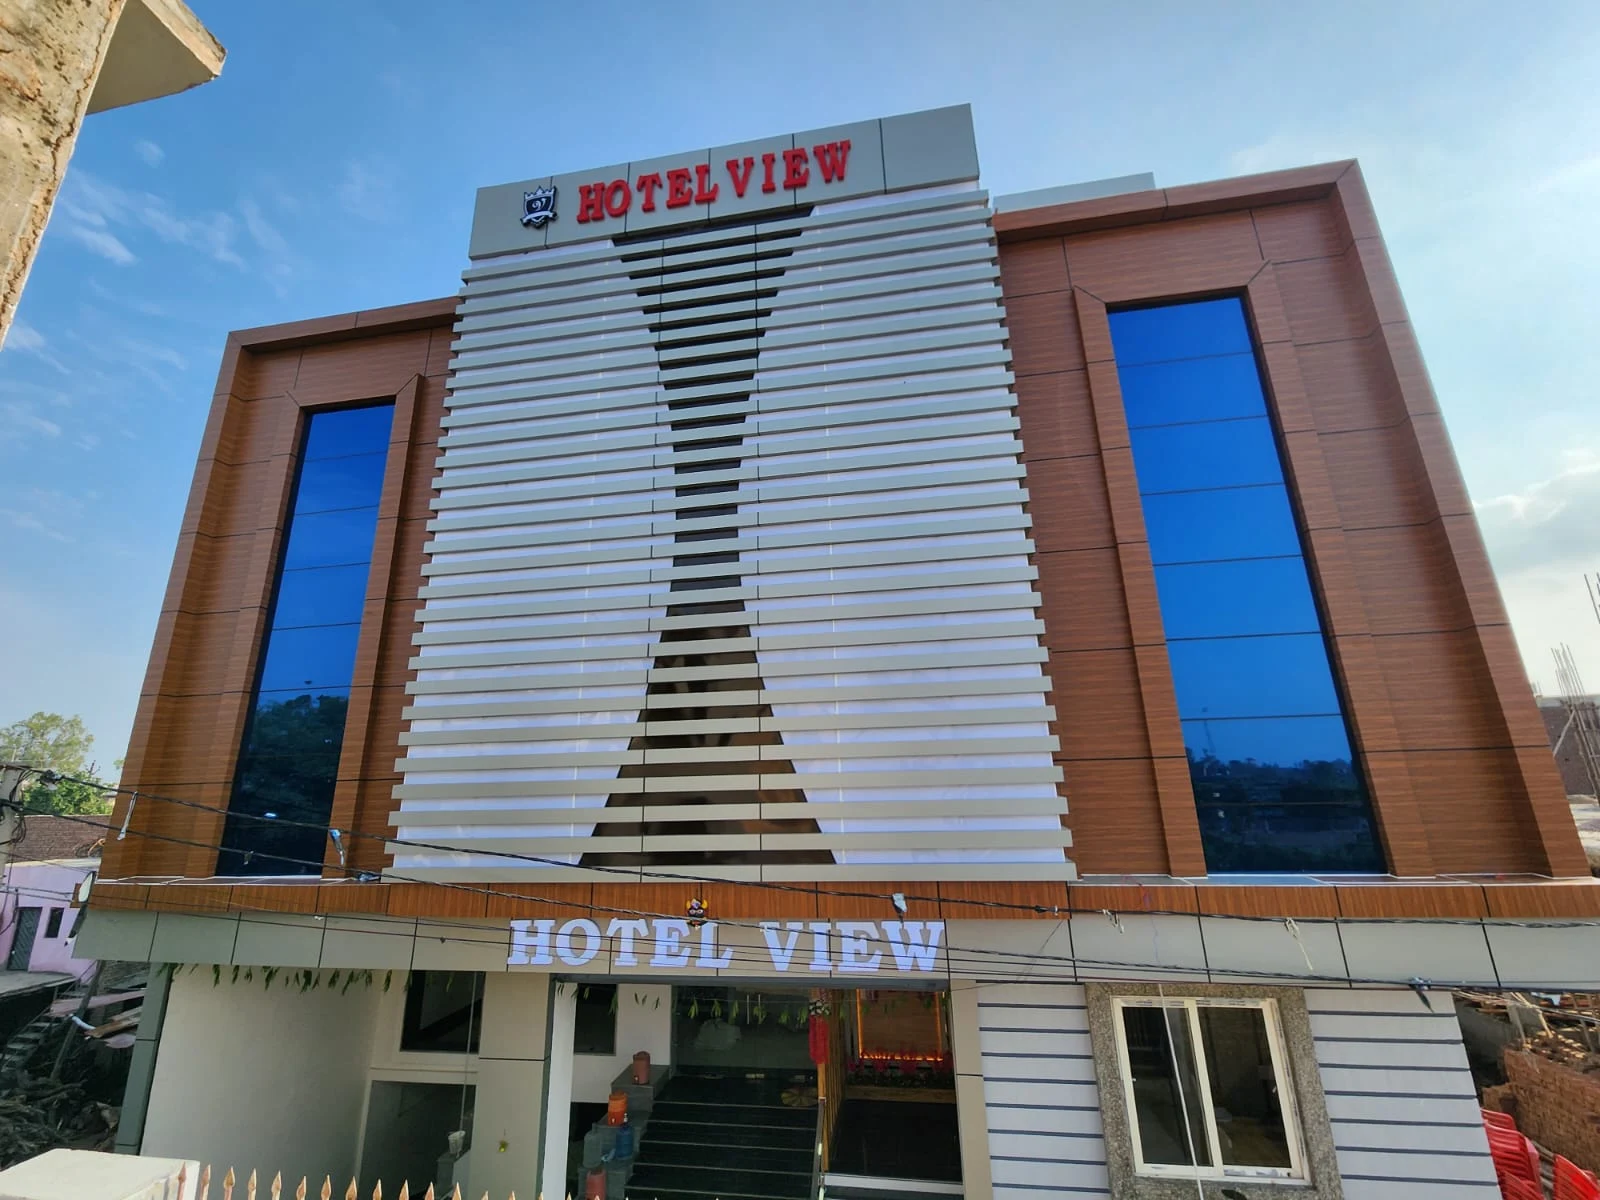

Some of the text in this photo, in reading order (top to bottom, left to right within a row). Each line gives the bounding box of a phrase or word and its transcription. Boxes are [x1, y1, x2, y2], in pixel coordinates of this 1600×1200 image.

[576, 138, 851, 224] HOTEL VIEW
[507, 917, 945, 973] HOTEL VIEW
